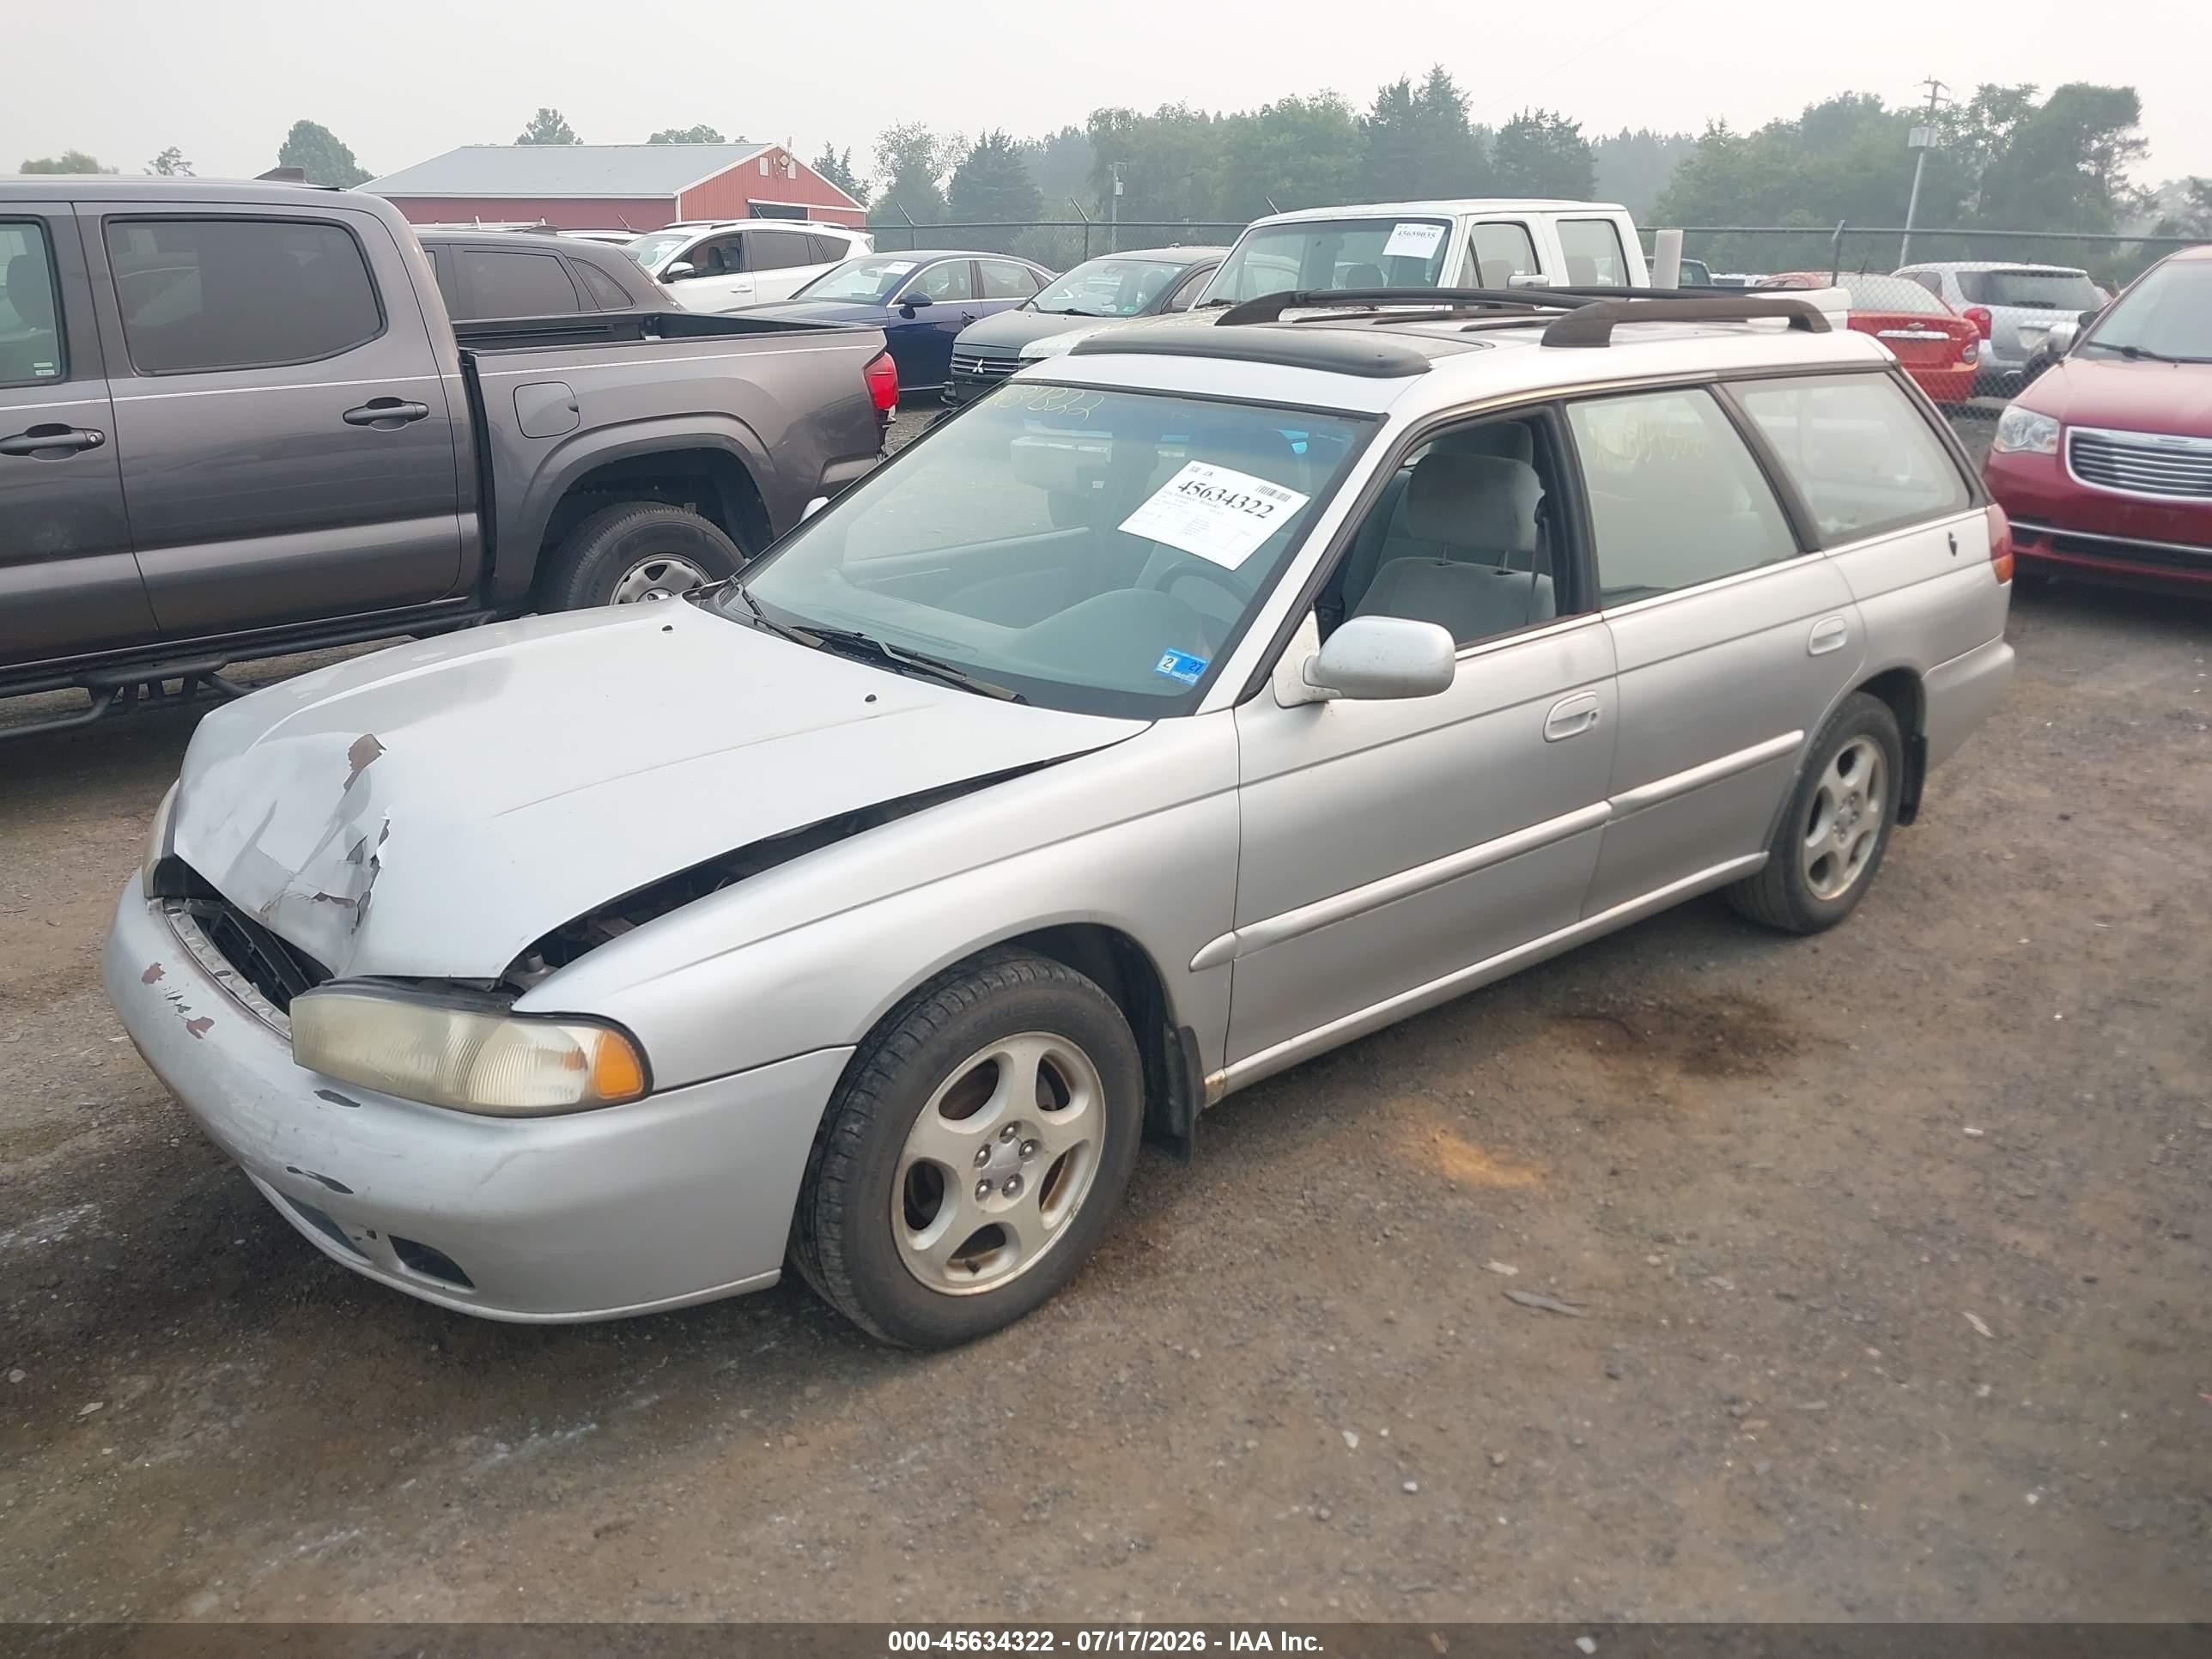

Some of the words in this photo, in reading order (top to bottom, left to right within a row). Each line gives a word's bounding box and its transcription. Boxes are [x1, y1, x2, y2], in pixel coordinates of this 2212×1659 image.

[1177, 480, 1274, 519] 45634322
[1163, 657, 1175, 668] 2
[1188, 661, 1204, 672] 27
